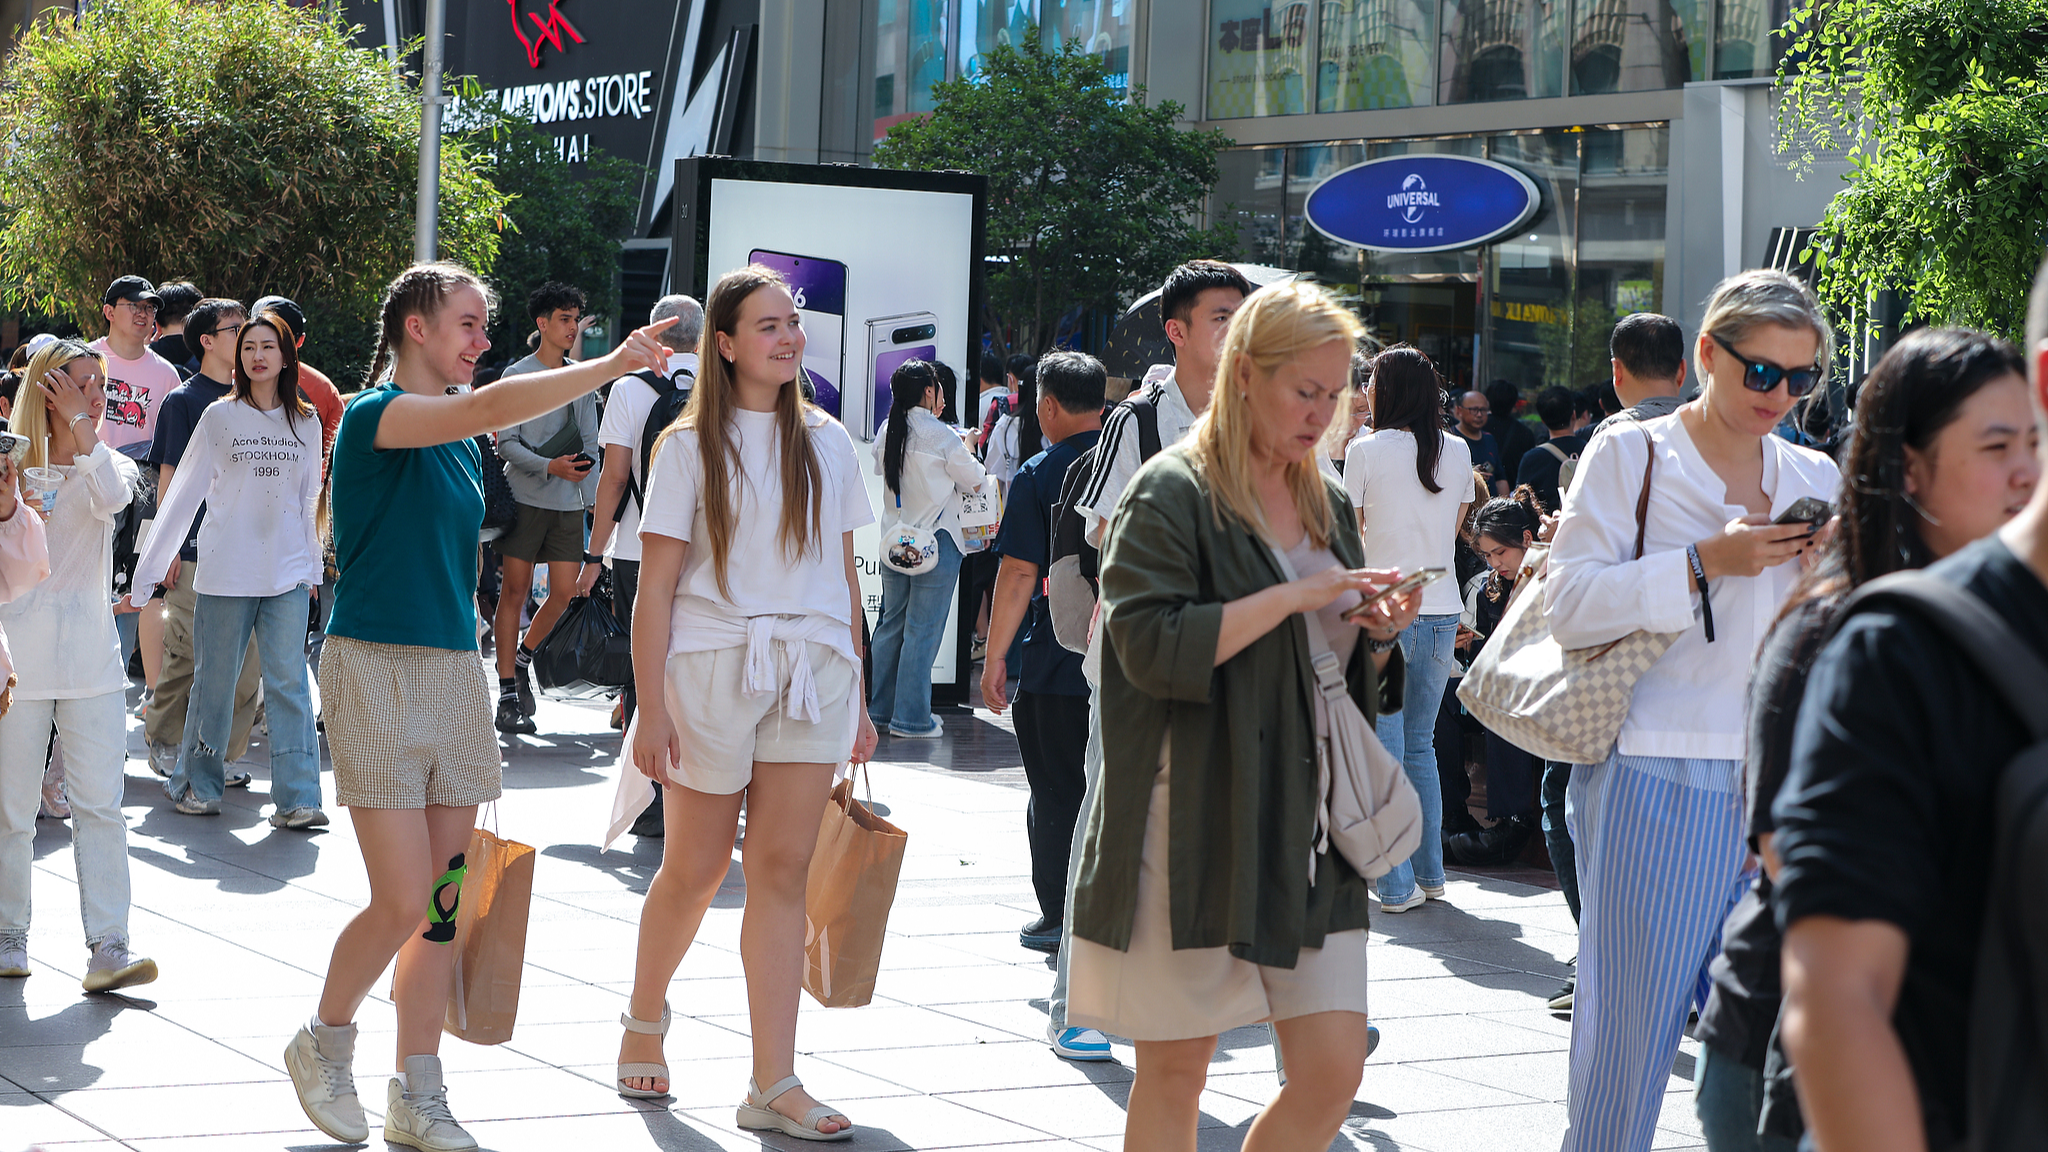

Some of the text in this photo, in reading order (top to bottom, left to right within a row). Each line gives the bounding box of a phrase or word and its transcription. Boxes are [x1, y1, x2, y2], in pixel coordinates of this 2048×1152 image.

[1387, 191, 1440, 209] UNIVERSAL
[232, 436, 298, 448] Acne Studios
[231, 451, 299, 463] STOCKHOLM
[253, 466, 280, 477] 1996
